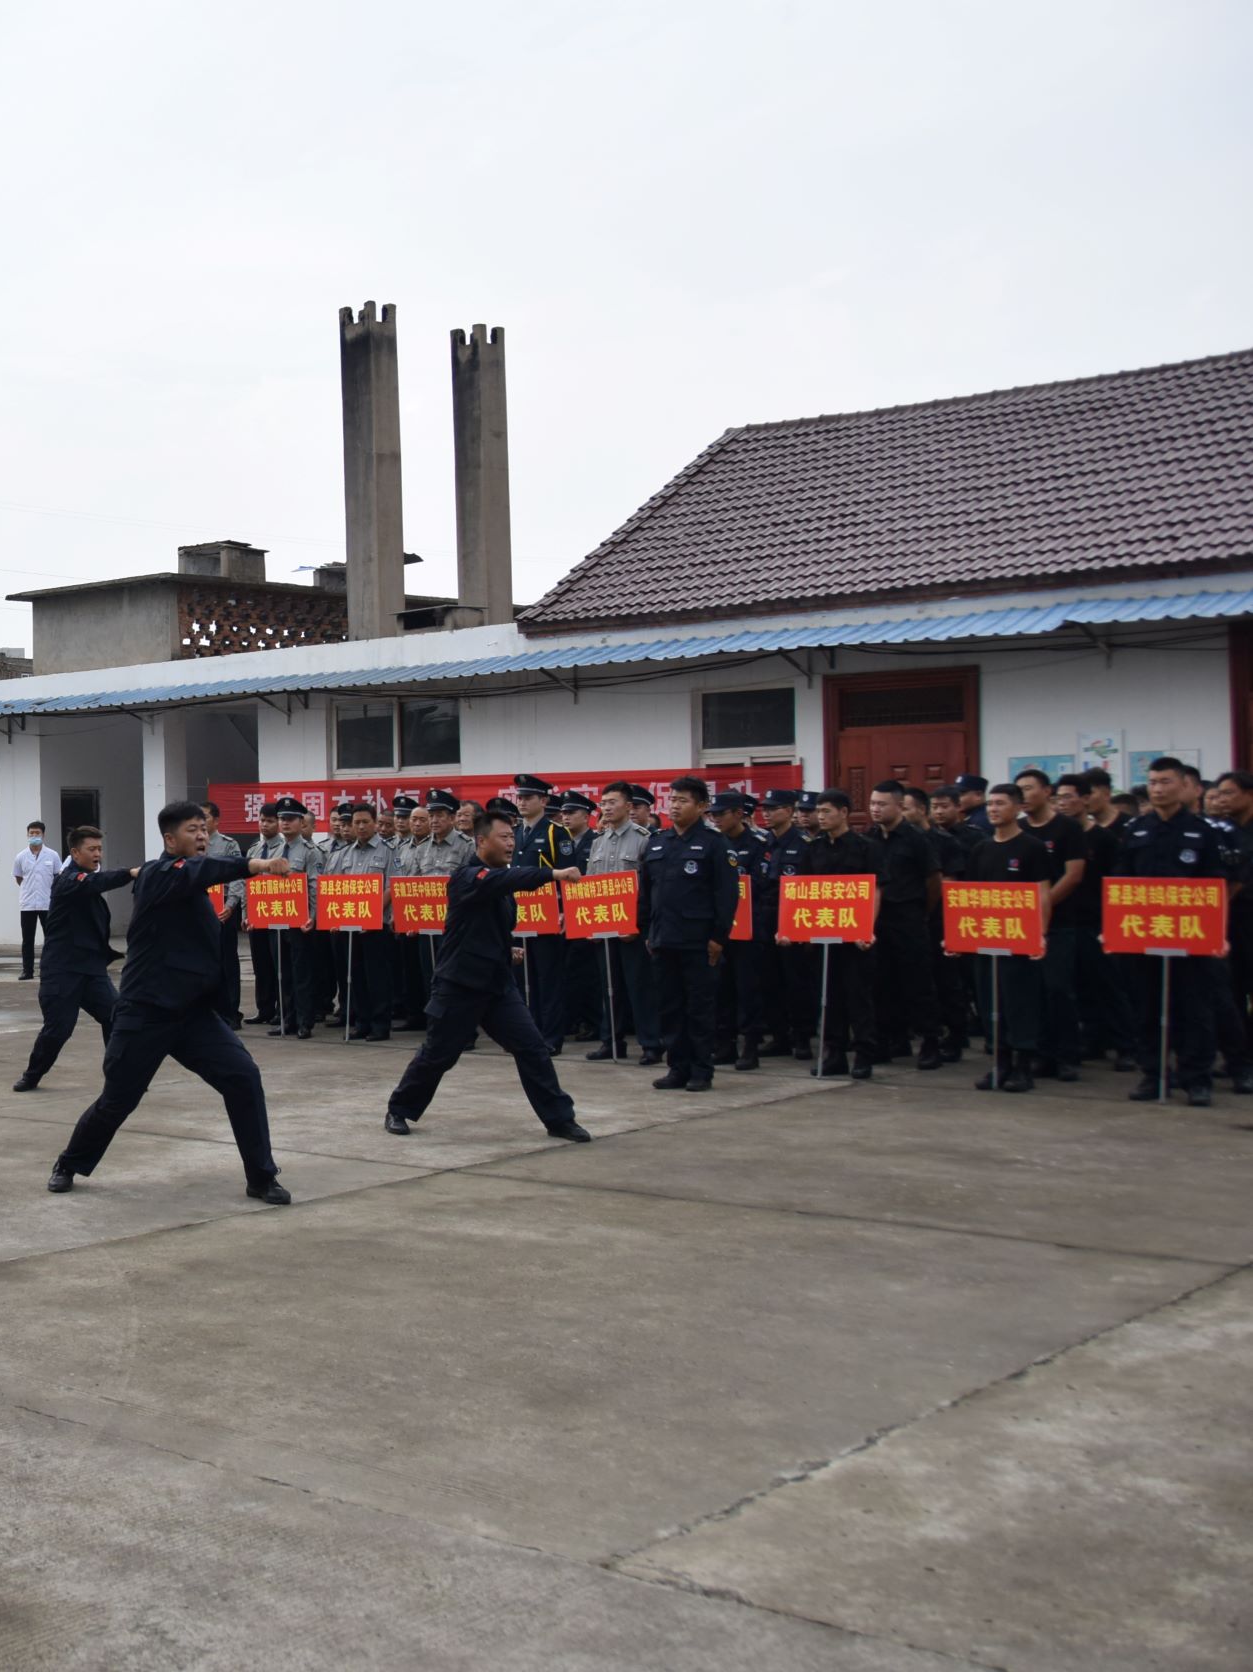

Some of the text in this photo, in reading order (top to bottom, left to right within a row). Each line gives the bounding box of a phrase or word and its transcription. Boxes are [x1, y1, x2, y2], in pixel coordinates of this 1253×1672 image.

[256, 899, 299, 918] 代表队
[327, 900, 372, 919] 代表队
[575, 902, 628, 926] 代表队
[793, 907, 858, 928] 代表队
[958, 916, 1026, 939] 代表队
[1120, 914, 1205, 939] 代表队
